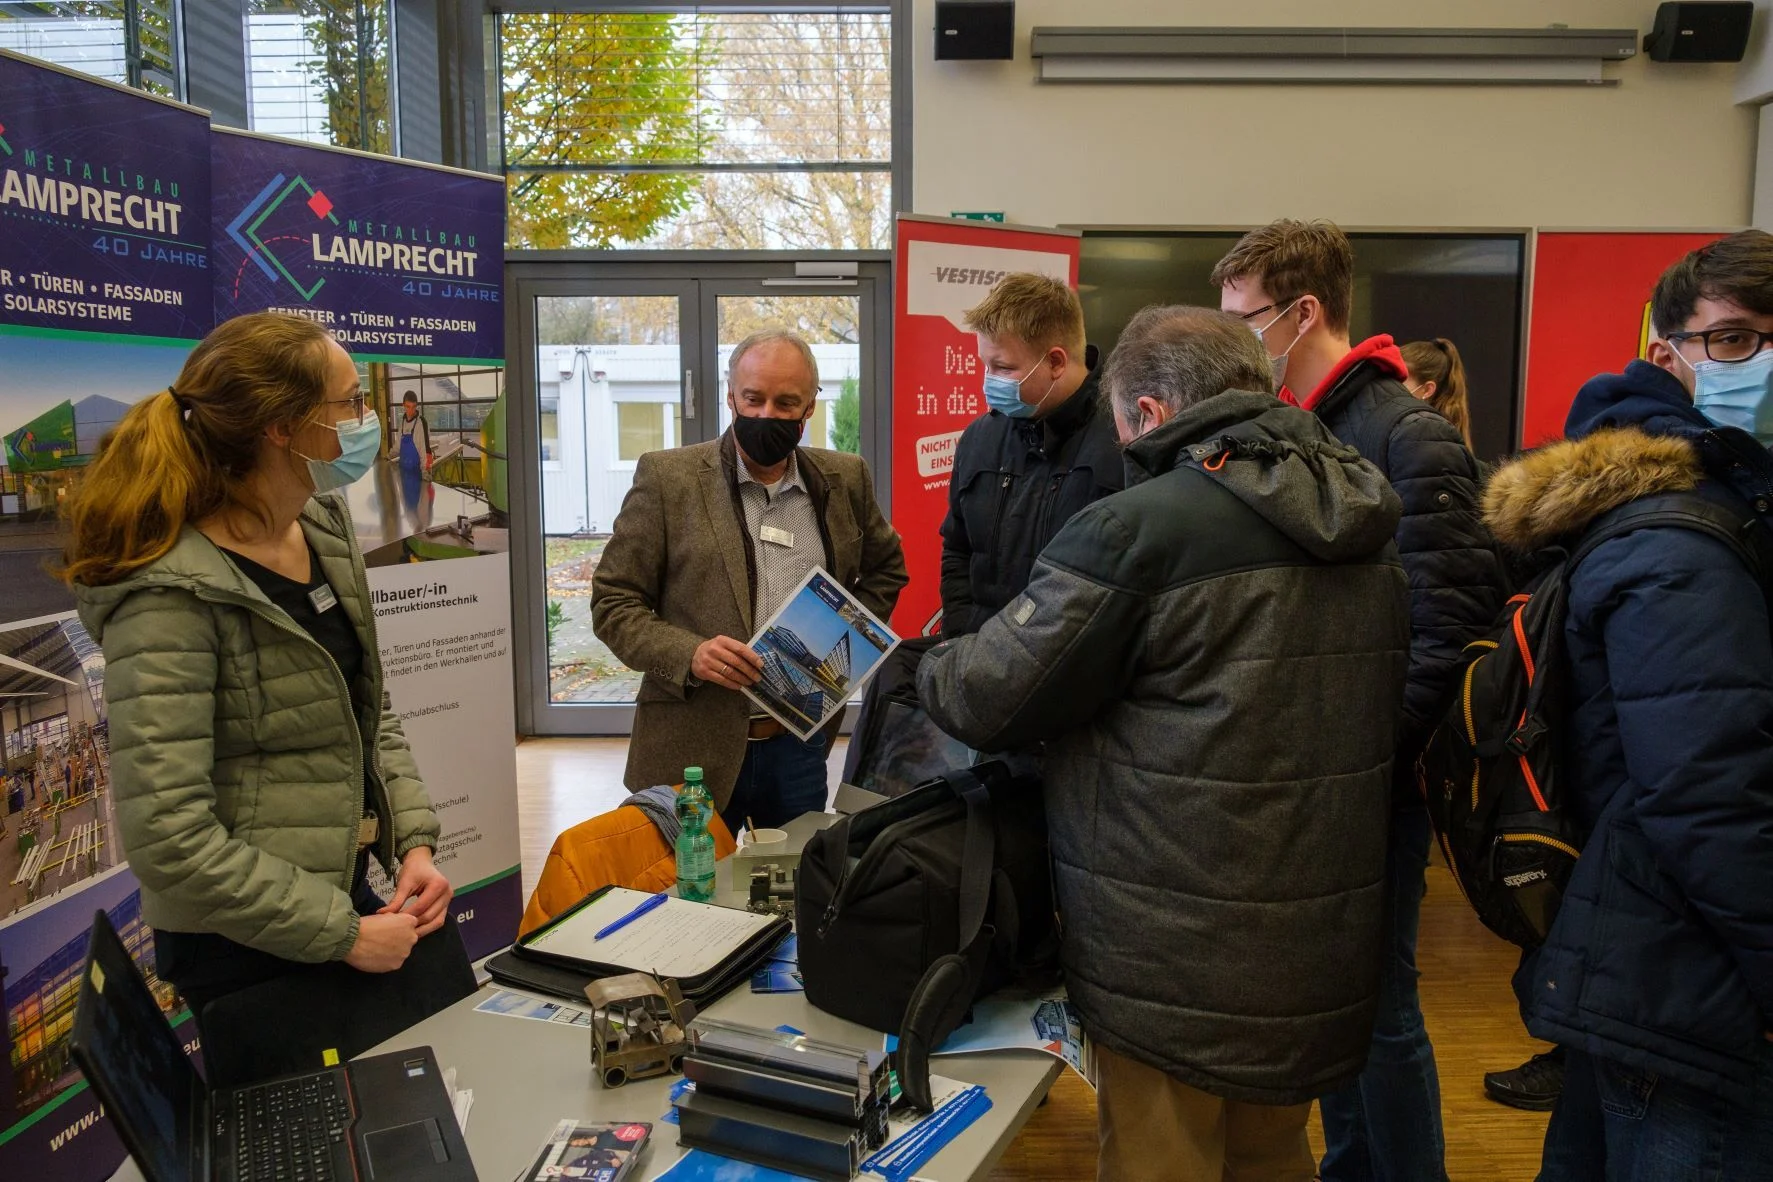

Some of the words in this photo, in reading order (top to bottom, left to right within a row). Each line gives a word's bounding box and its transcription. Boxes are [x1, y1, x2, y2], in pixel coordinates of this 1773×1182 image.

[25, 149, 180, 198] METALLBAU
[0, 169, 182, 235] AMPRECHT
[348, 219, 476, 247] METALLBAU
[92, 236, 129, 256] 40
[140, 244, 208, 269] JAHRE
[312, 233, 478, 277] LAMPRECHT
[31, 272, 84, 295] TÜREN
[104, 283, 183, 306] FASSADEN
[402, 281, 432, 296] 40
[441, 284, 499, 302] JAHRE
[4, 294, 133, 322] SOLARSYSTEME
[350, 311, 394, 328] TÜREN
[410, 317, 476, 333] FASSADEN
[945, 345, 976, 375] Die
[917, 386, 937, 415] in
[947, 386, 978, 415] die
[921, 439, 952, 455] NICHT
[416, 640, 430, 650] und
[432, 634, 469, 648] Fassaden
[470, 628, 496, 641] anhand
[481, 639, 494, 650] und
